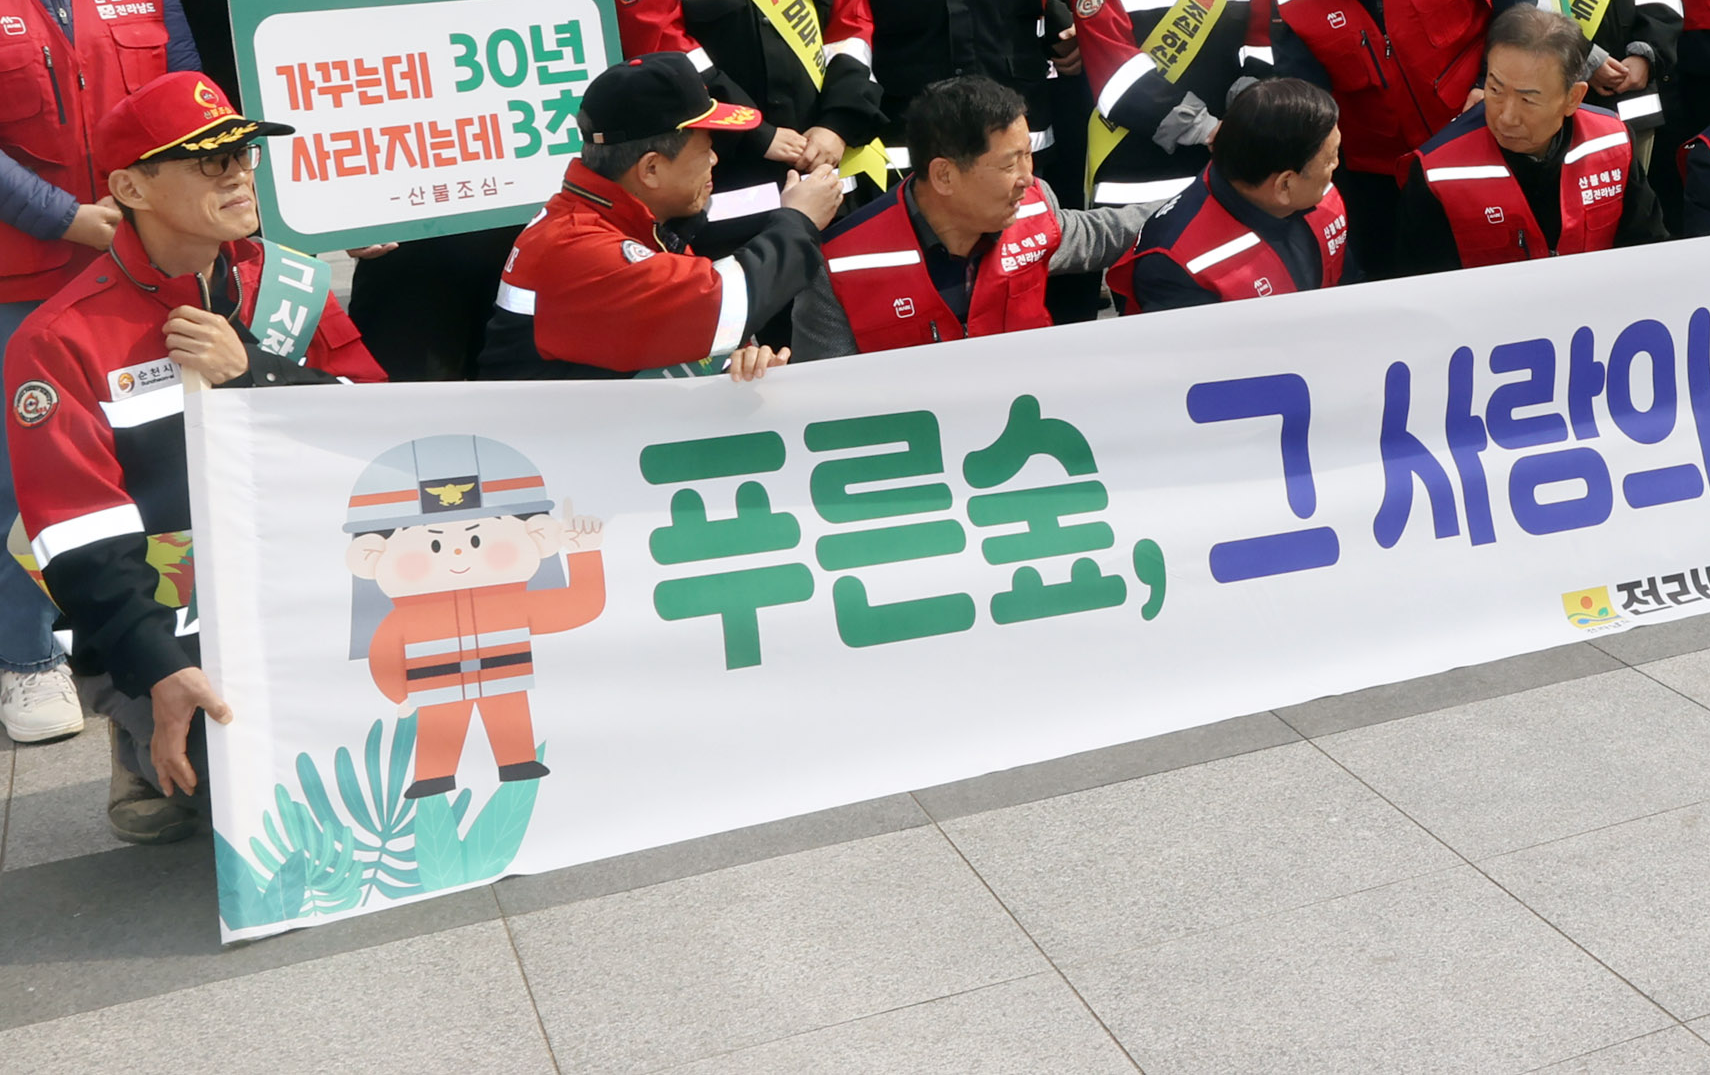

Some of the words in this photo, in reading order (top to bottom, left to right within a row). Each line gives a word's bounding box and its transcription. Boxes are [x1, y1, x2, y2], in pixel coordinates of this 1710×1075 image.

[116, 2, 156, 16] 전라남도
[276, 52, 433, 111] 가꾸는데
[449, 20, 588, 93] 30년
[291, 113, 504, 182] 사라지는데
[507, 89, 583, 158] 3초
[1579, 167, 1622, 189] 산불예방
[137, 363, 174, 381] 순천시
[640, 394, 1166, 672] 푸른숲,
[1186, 372, 1340, 584] 그
